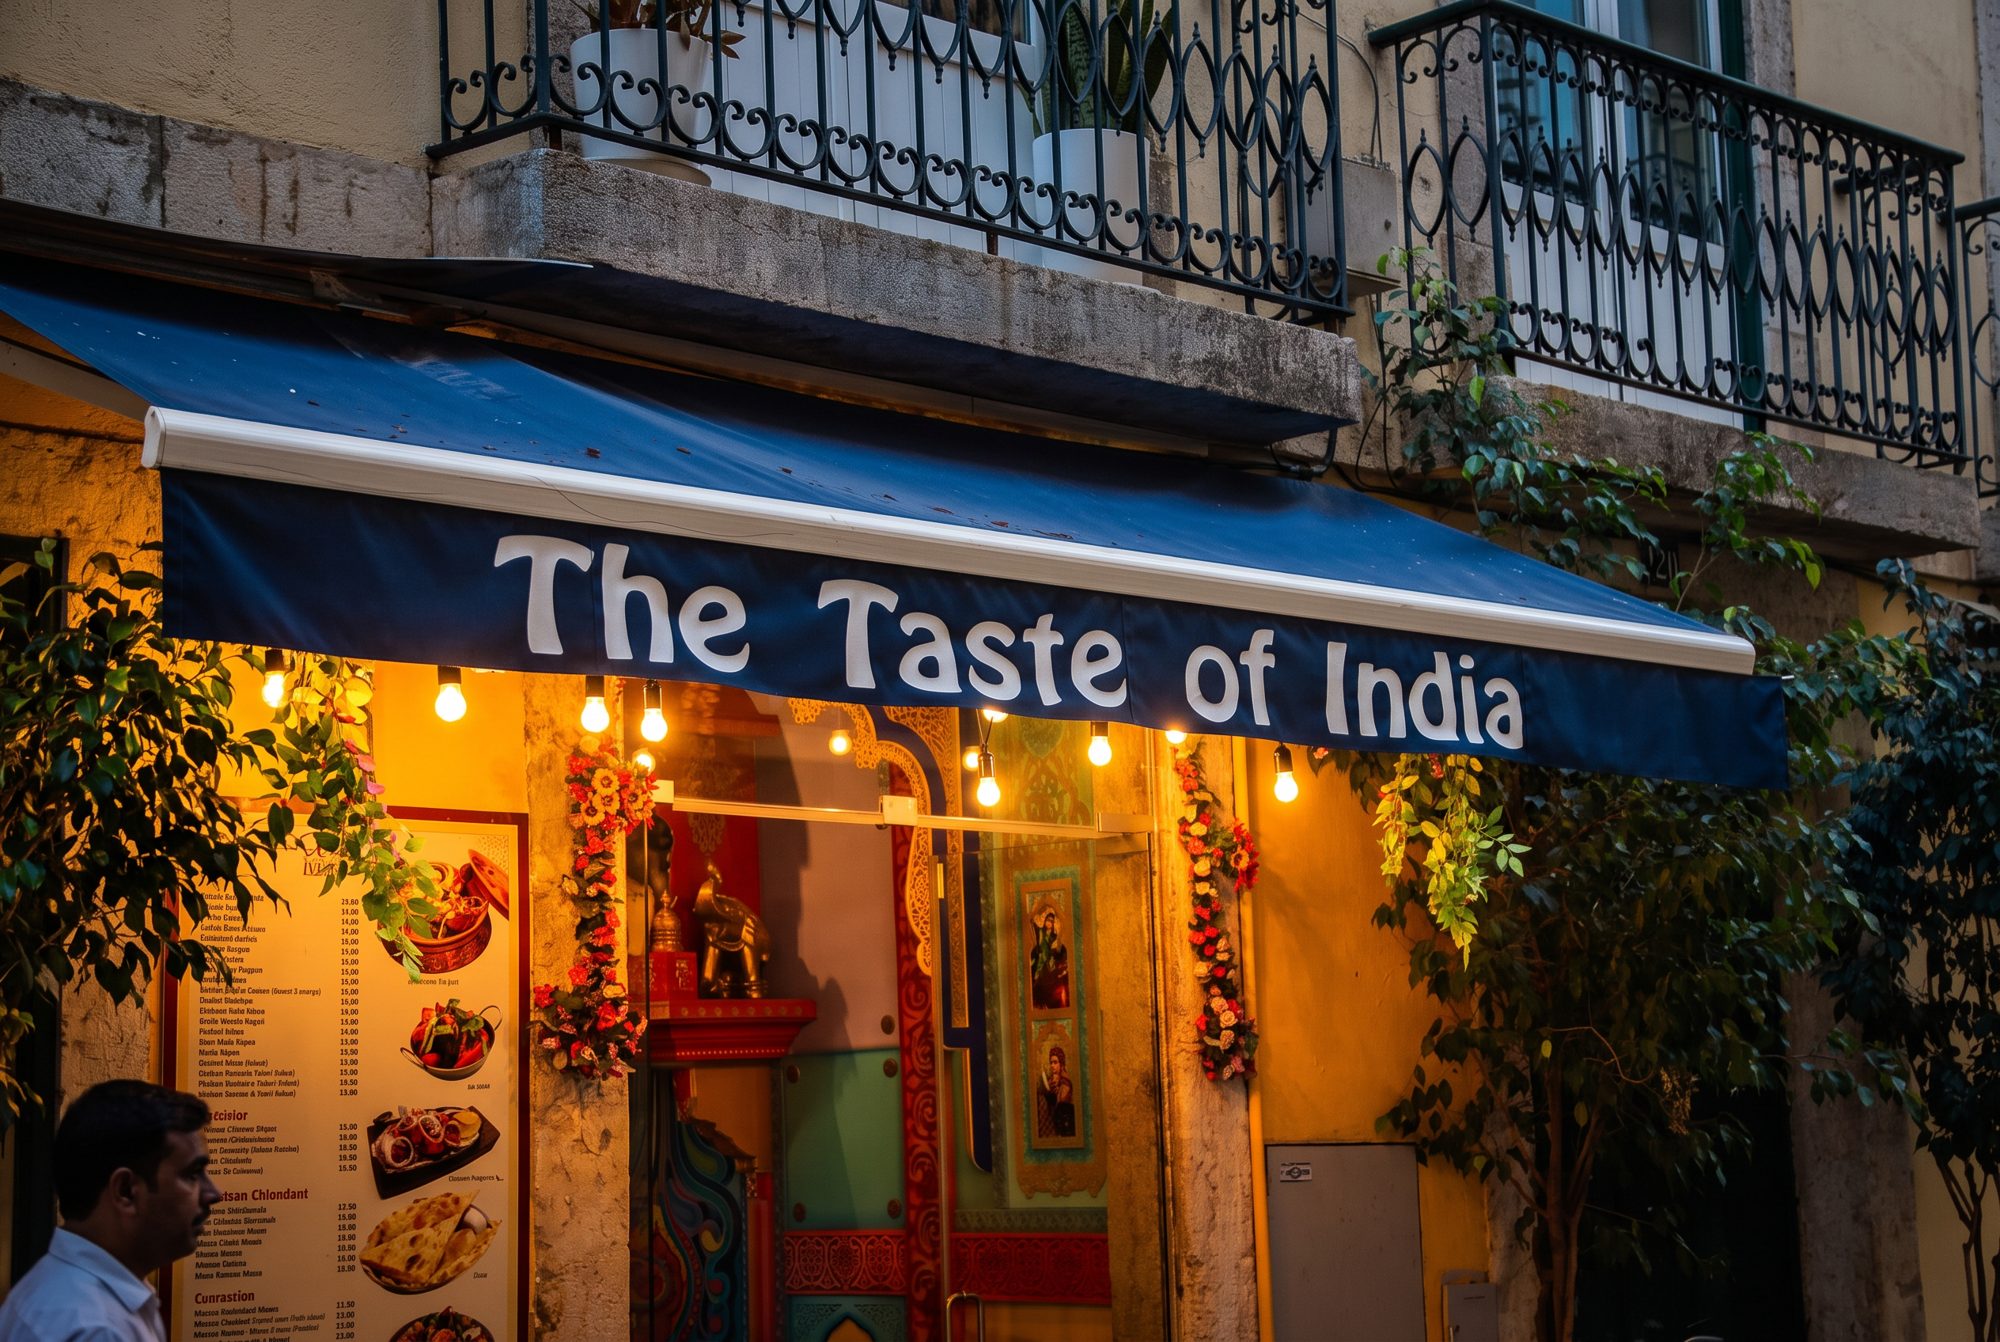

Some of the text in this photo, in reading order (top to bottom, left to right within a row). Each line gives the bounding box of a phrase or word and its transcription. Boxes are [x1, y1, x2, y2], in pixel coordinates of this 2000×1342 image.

[493, 534, 1524, 749] The Taste of India
